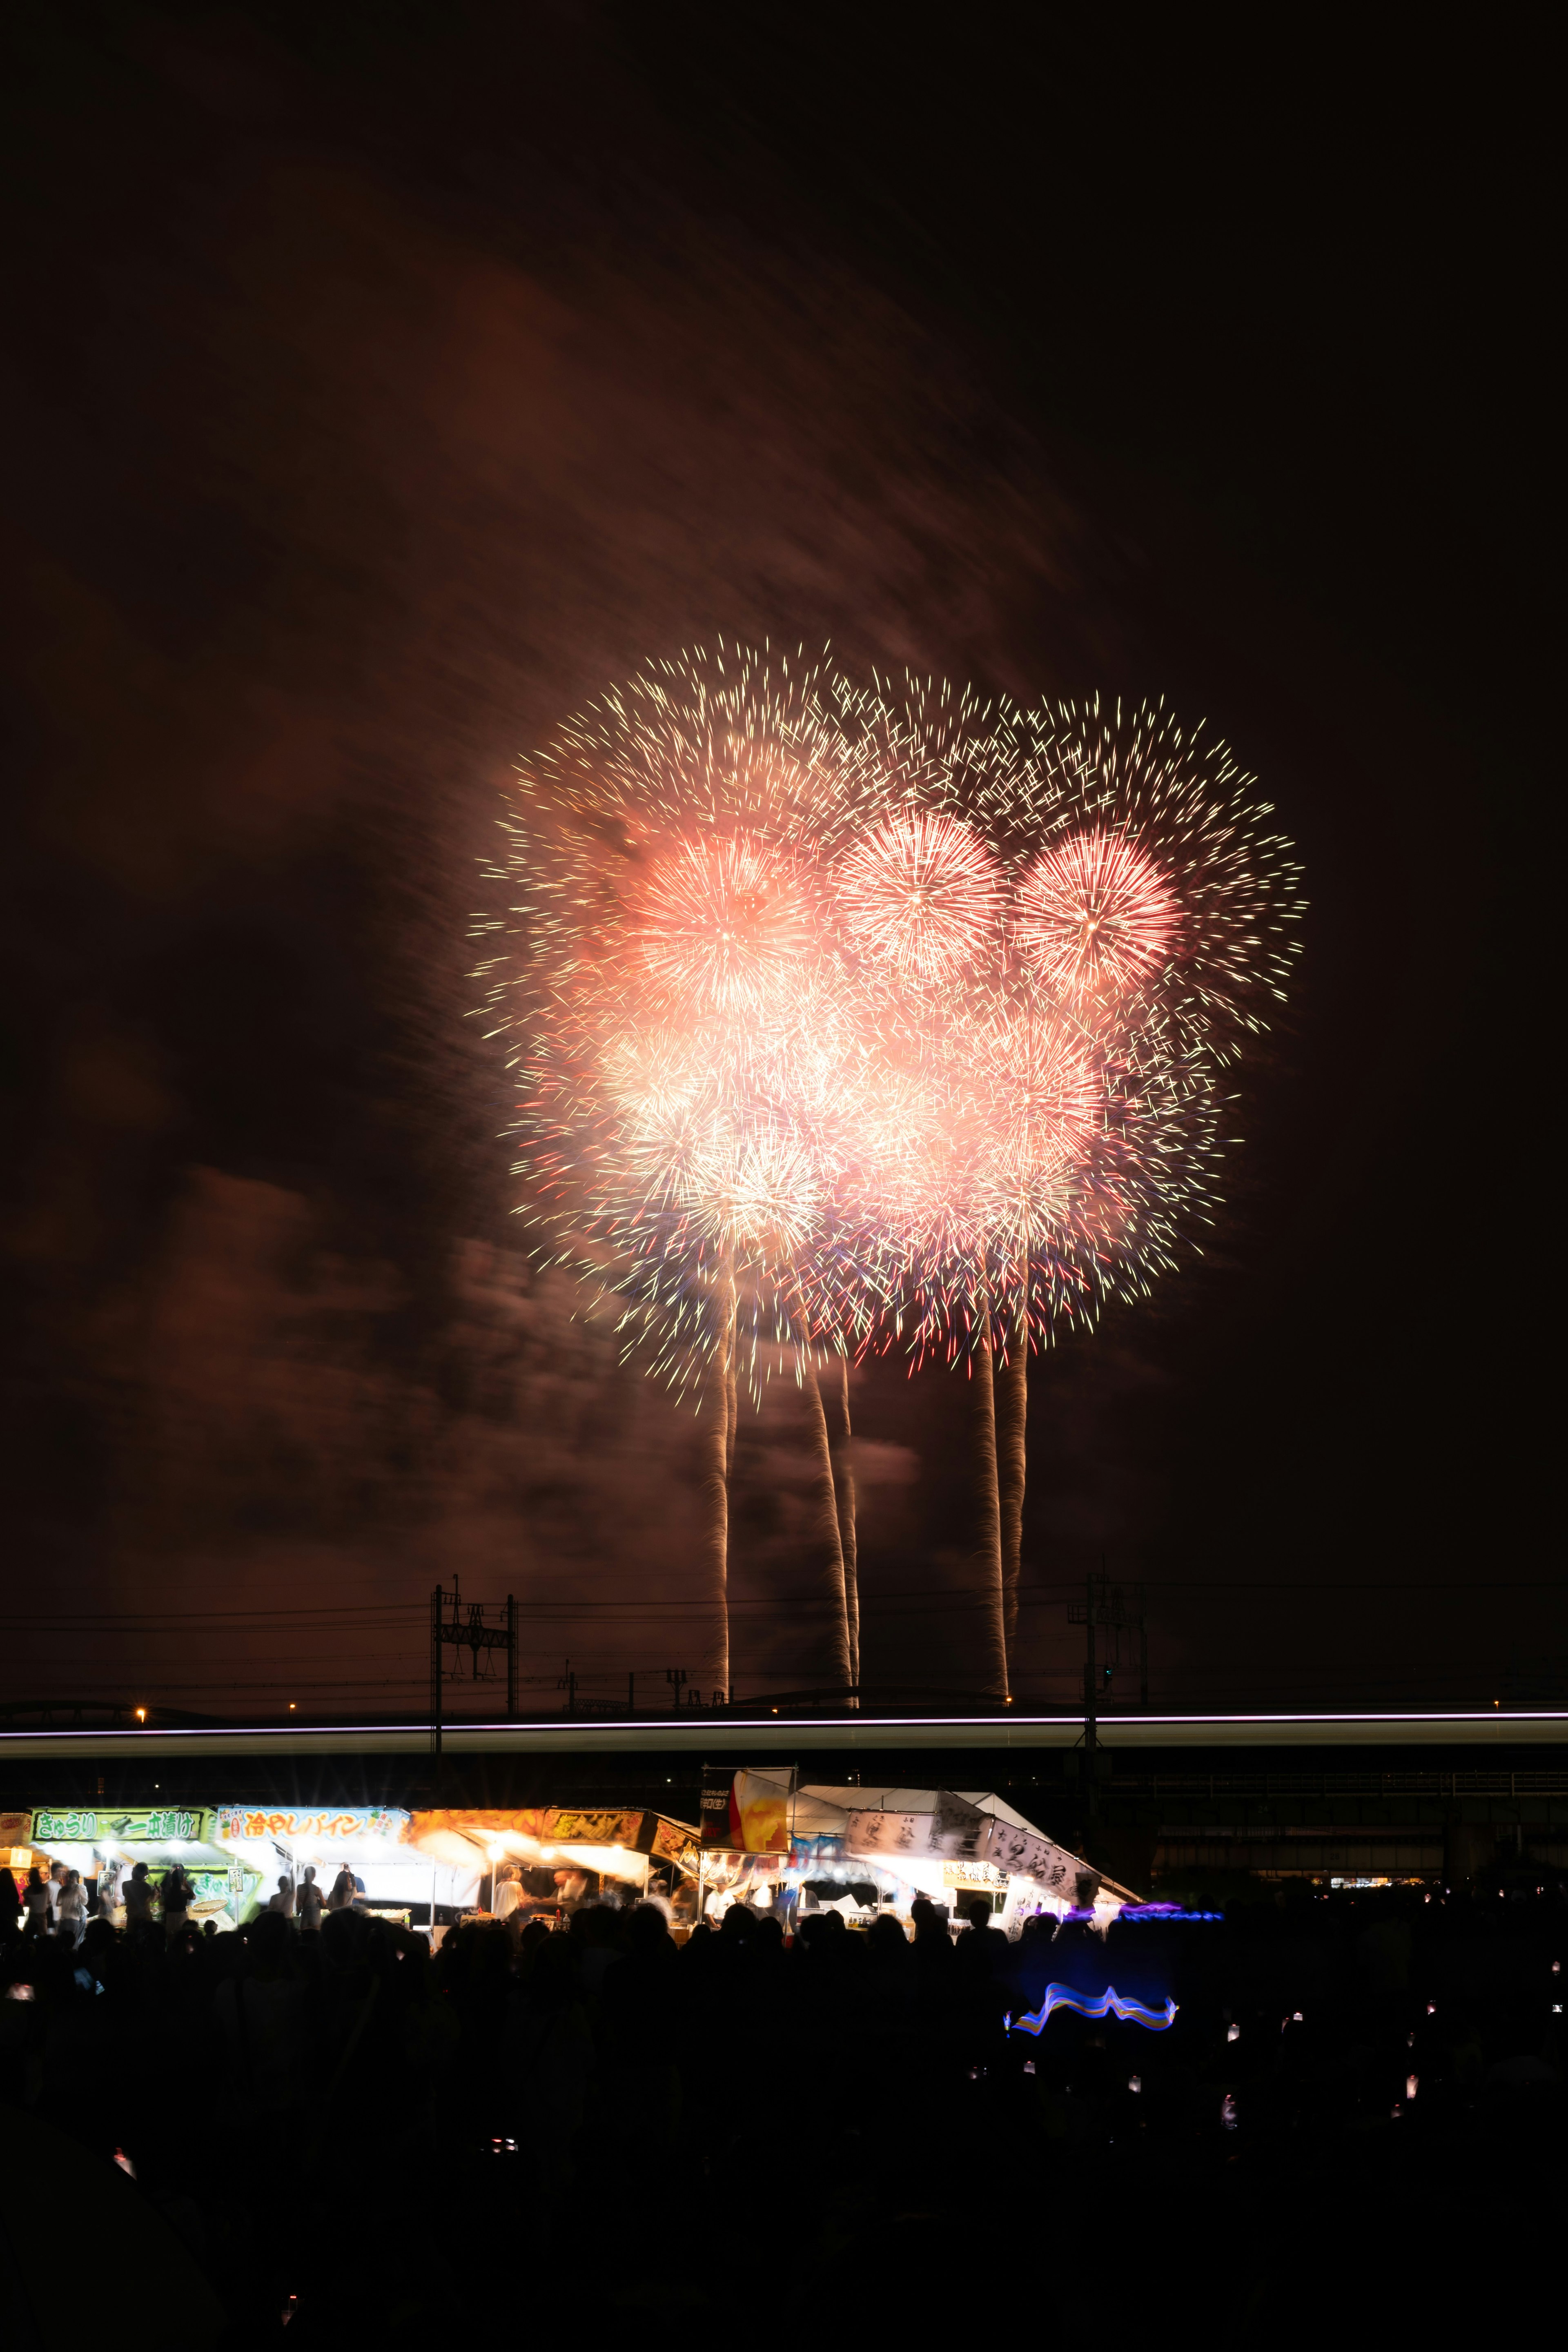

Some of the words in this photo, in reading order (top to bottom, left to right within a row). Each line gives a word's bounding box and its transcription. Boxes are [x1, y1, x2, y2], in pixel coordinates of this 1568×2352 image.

[38, 1812, 97, 1838] きゅうり
[126, 1811, 194, 1838] 一本漬け
[244, 1811, 365, 1837] 冷やしパイン
